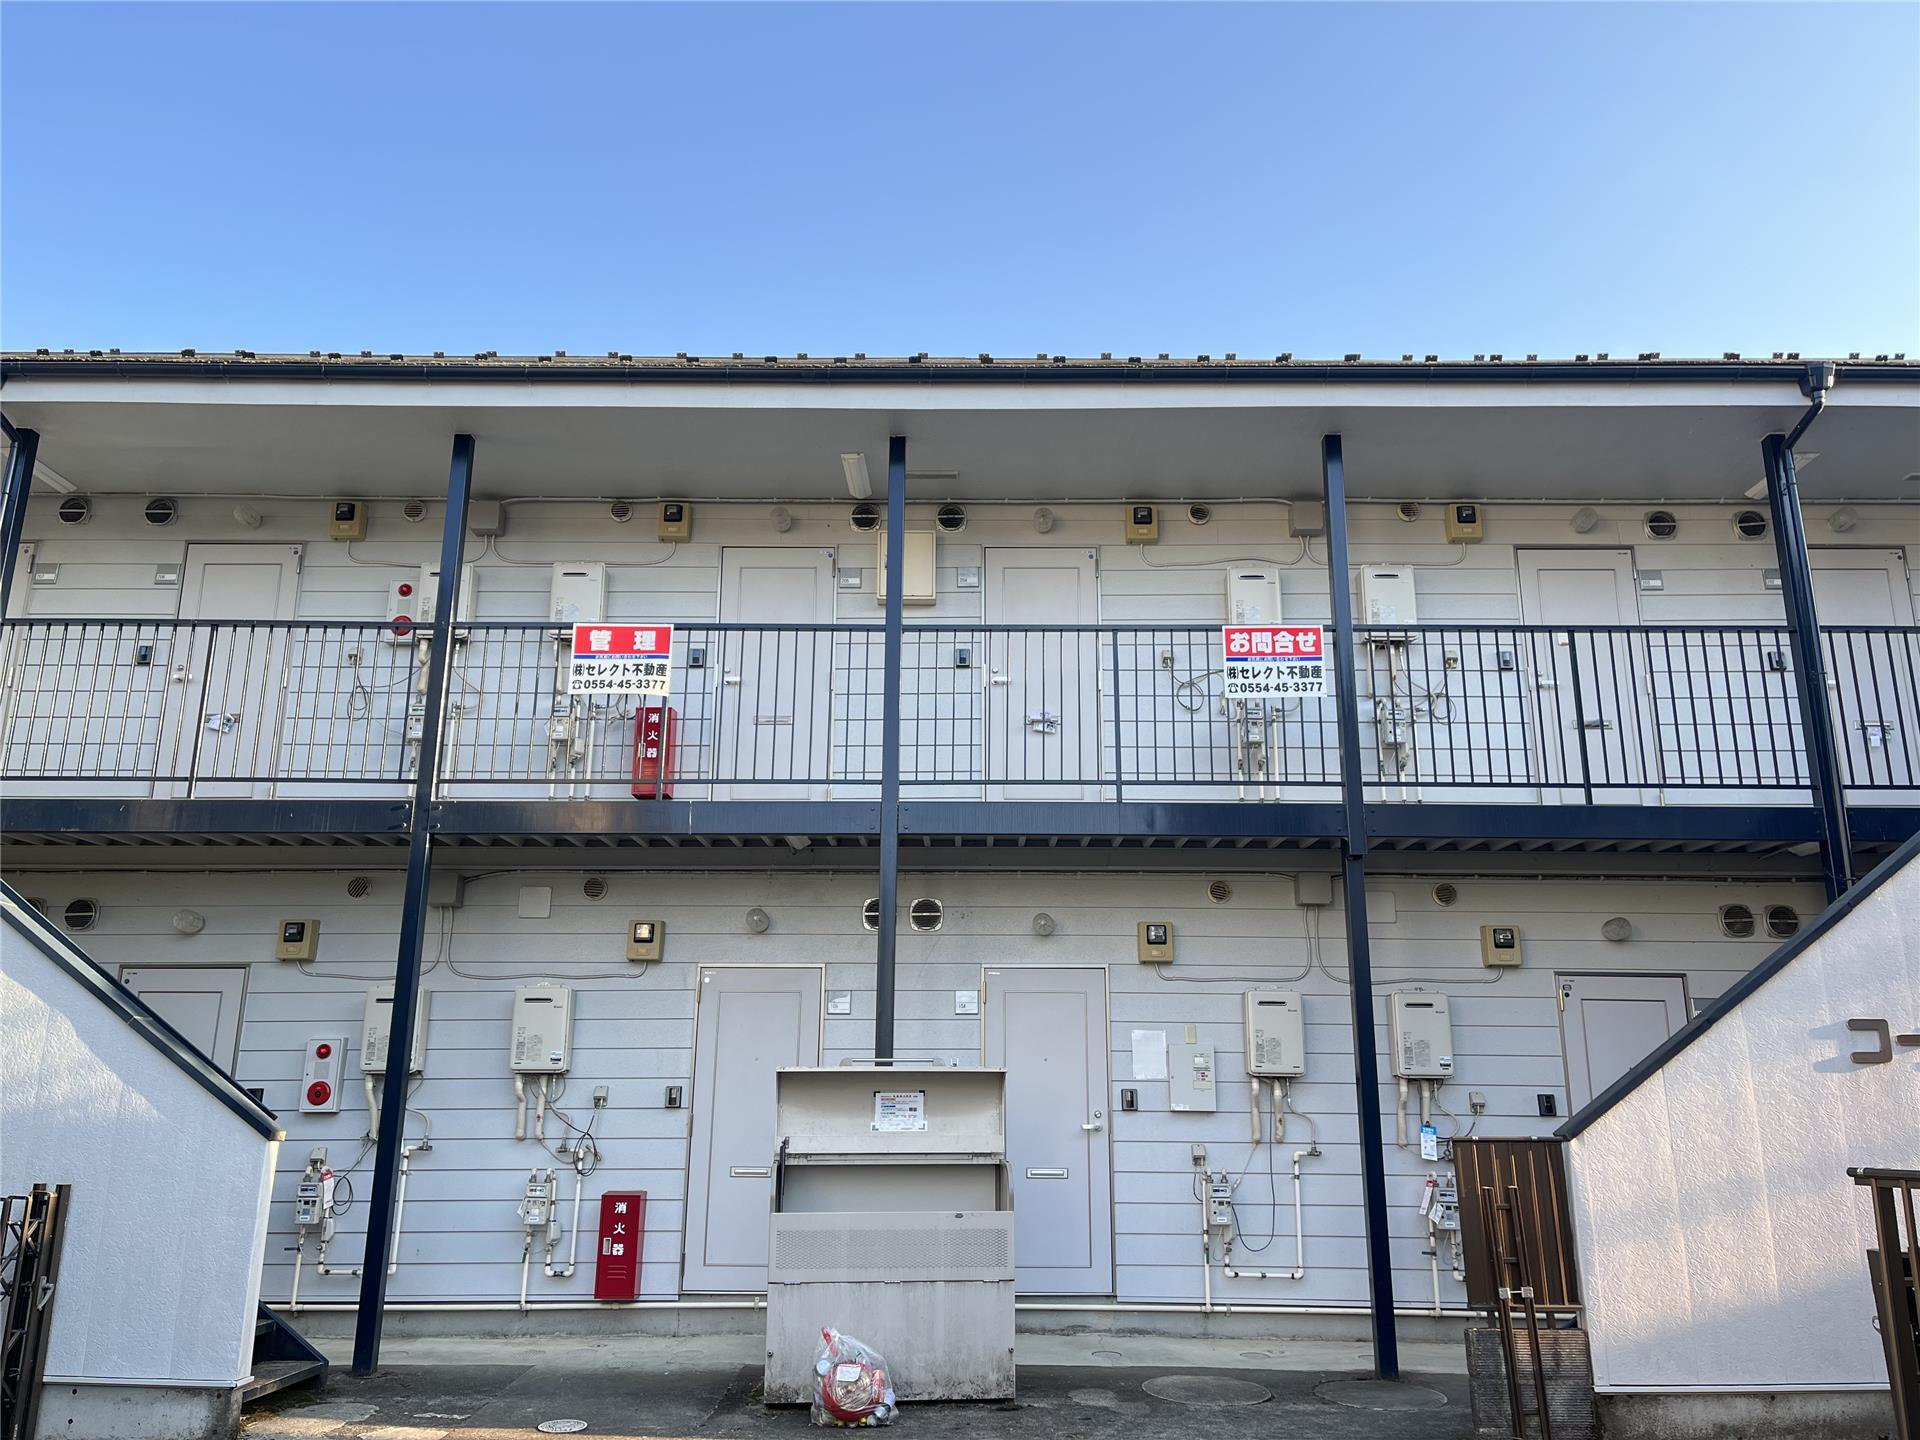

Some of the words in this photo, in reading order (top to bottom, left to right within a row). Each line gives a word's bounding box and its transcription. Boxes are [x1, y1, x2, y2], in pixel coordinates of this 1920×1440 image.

[589, 630, 656, 651] 管理
[1229, 631, 1317, 654] お問合せ
[584, 679, 665, 690] 0554-45-3377
[1240, 682, 1322, 693] 0554-45-3377
[647, 713, 659, 758] 消火器
[612, 1202, 627, 1256] 消火器
